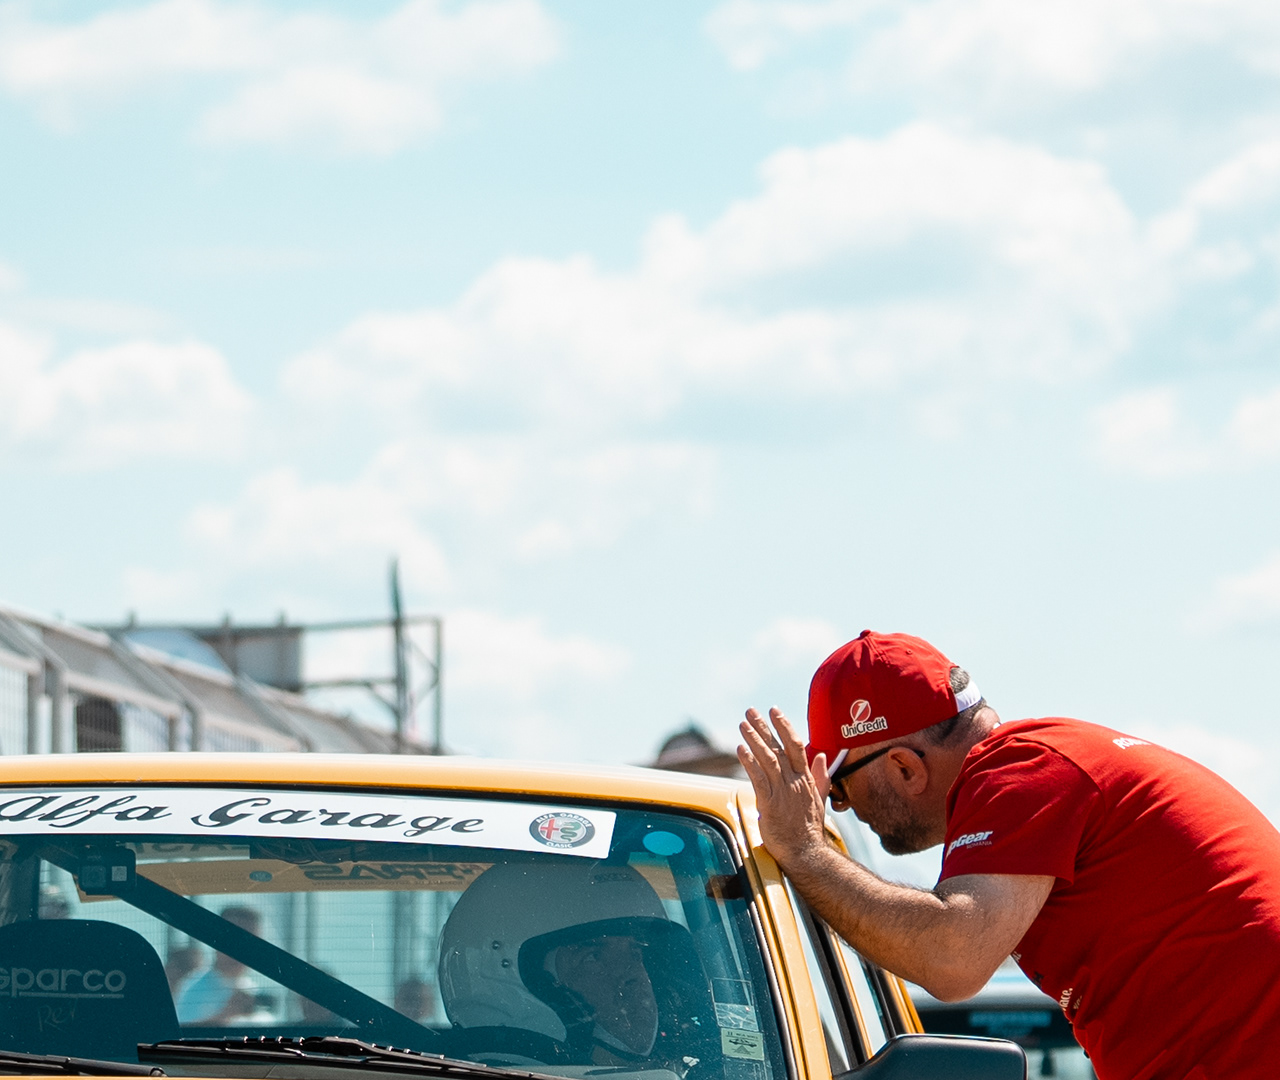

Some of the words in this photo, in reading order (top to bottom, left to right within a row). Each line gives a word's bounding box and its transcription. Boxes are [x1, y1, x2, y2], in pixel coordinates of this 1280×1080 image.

[841, 716, 888, 738] UniCredit
[190, 797, 485, 838] Garage
[536, 813, 556, 824] ALFA
[560, 813, 592, 828] GARAGE
